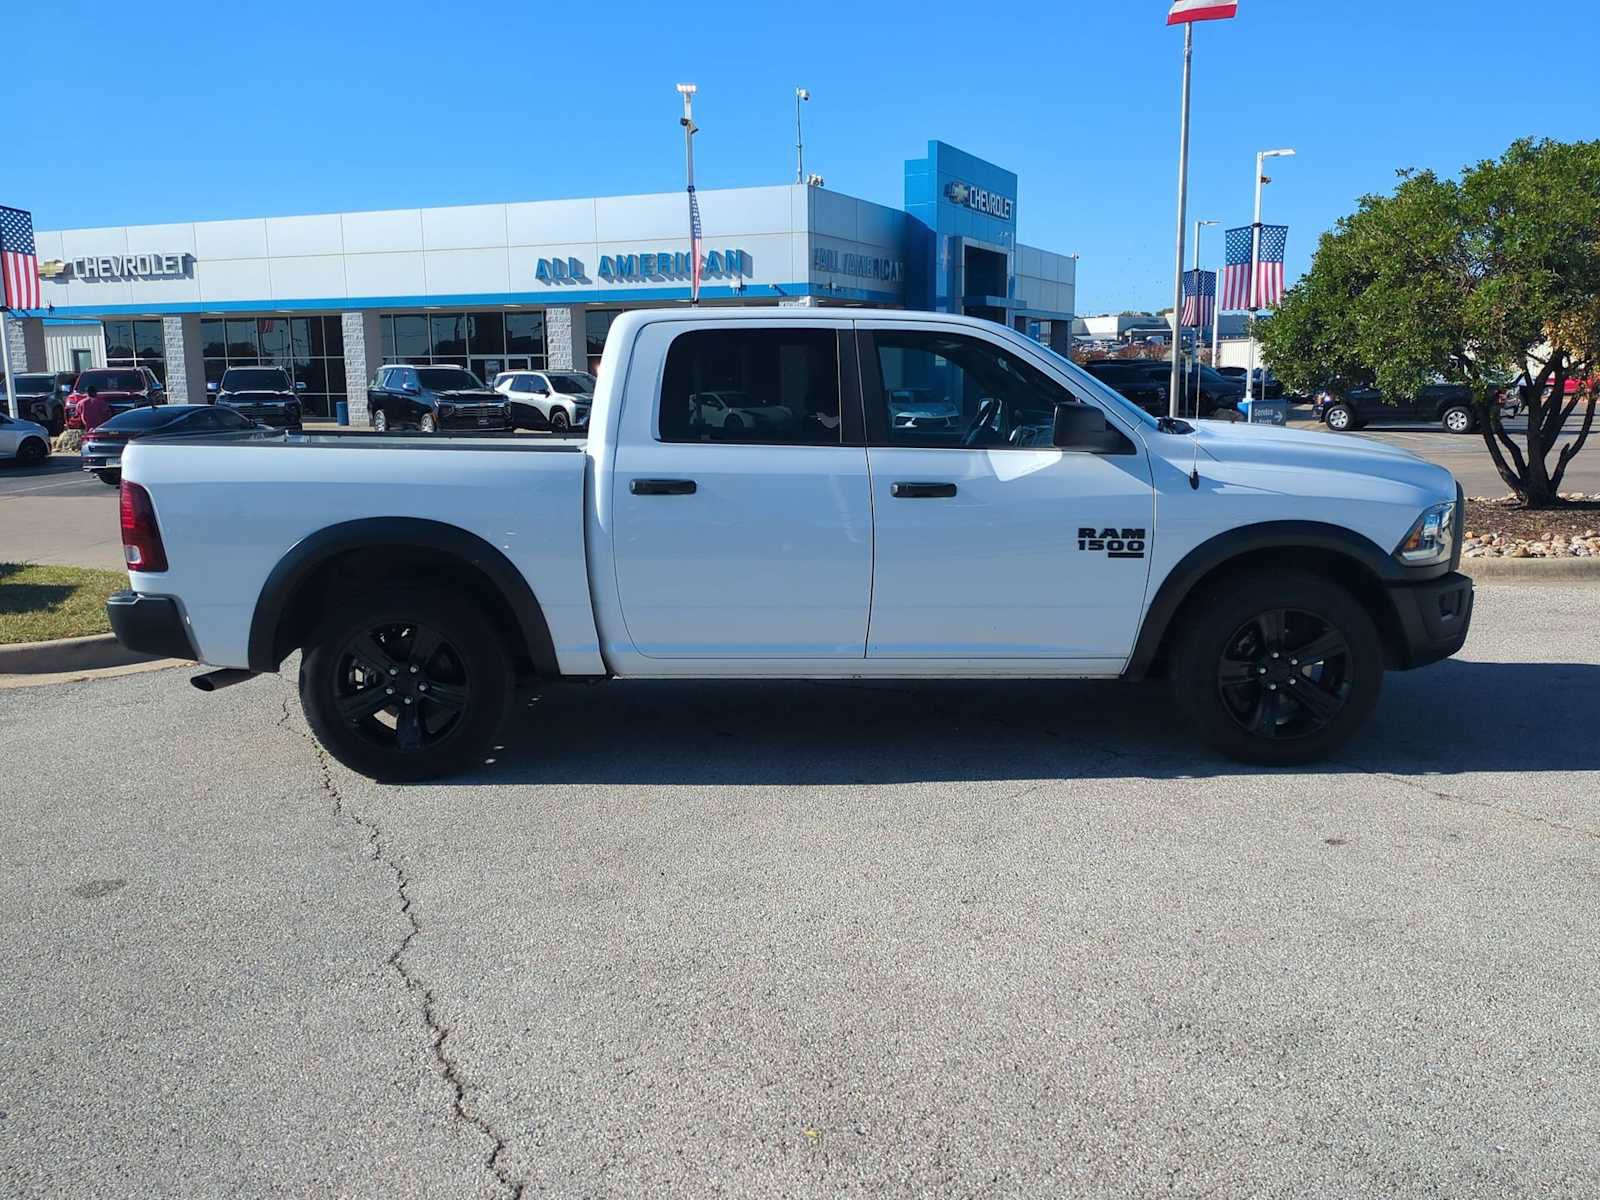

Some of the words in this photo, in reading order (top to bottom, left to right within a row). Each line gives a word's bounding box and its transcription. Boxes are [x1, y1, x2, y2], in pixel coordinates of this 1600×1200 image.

[969, 186, 1014, 219] CHEVROLET
[72, 253, 187, 279] CHEVROLET
[535, 256, 587, 281] ALL
[1078, 527, 1146, 539] RAM
[1078, 540, 1145, 551] 1500
